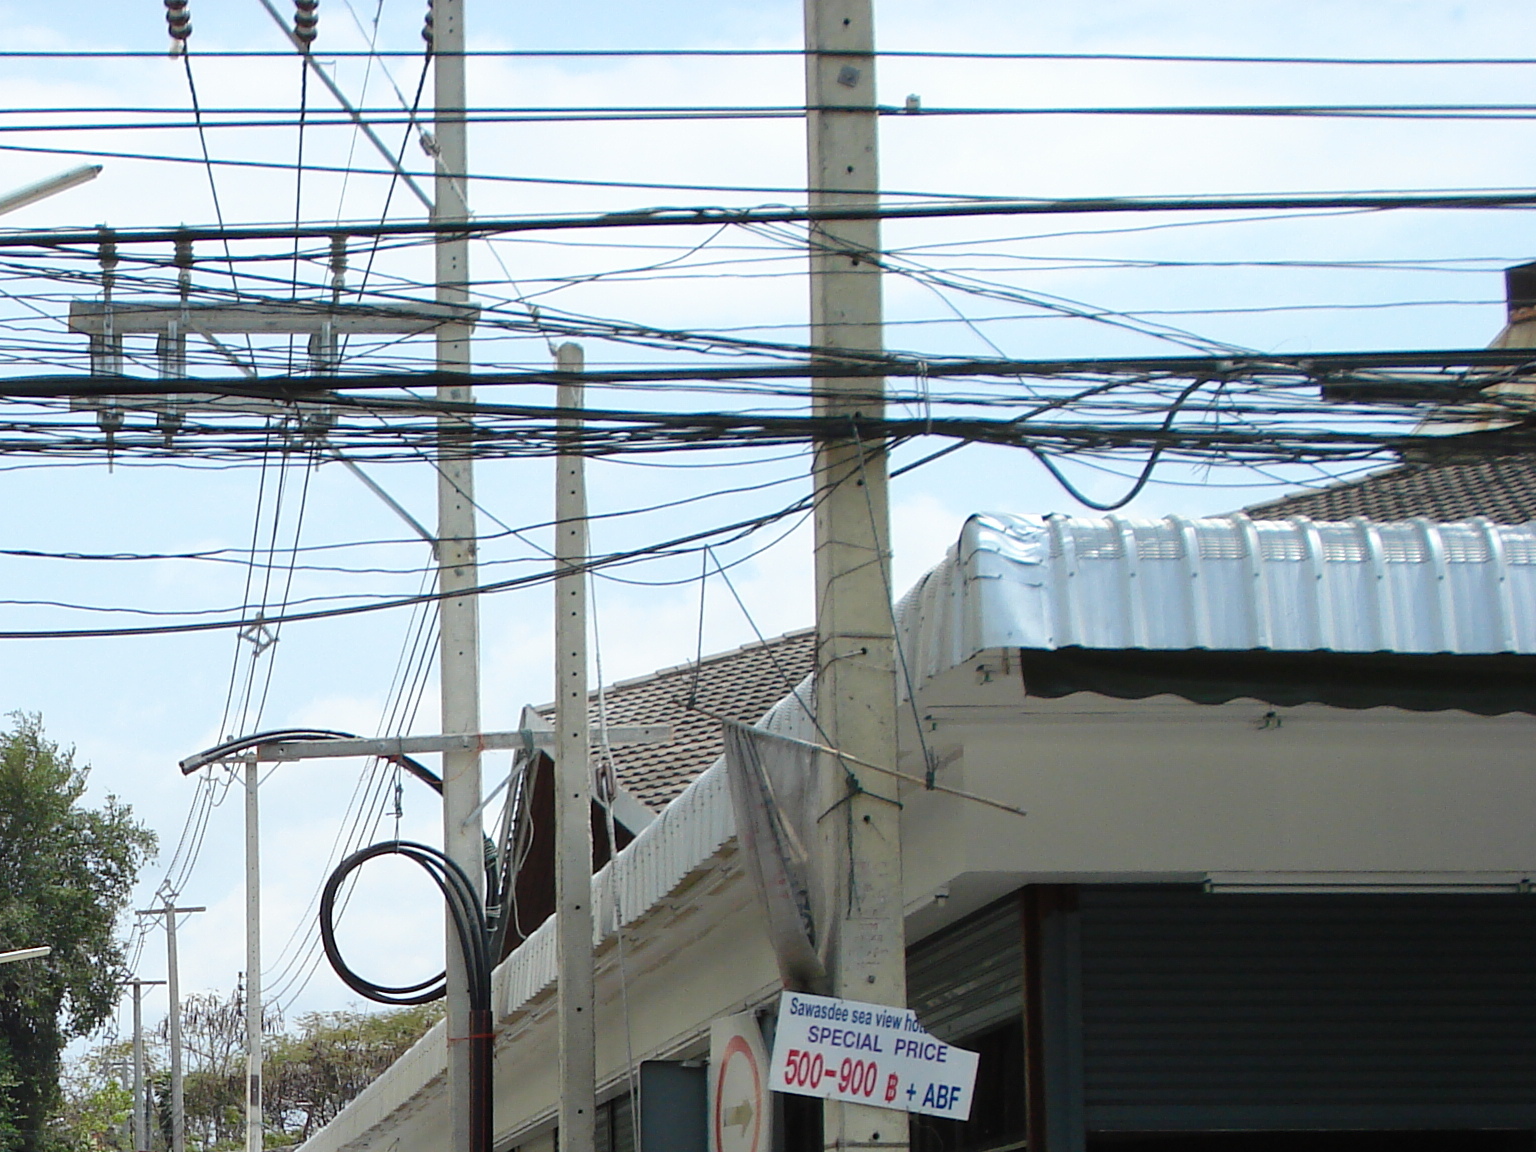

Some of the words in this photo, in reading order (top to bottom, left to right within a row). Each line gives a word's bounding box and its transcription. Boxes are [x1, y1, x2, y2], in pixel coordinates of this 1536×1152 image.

[789, 997, 849, 1023] Sawasdee
[851, 1009, 872, 1025] sea
[875, 1009, 903, 1030] view
[807, 1025, 883, 1052] SPECIAL
[894, 1038, 949, 1062] PRICE
[784, 1049, 877, 1097] 500-900
[906, 1083, 917, 1101] +
[922, 1083, 961, 1110] ABF
